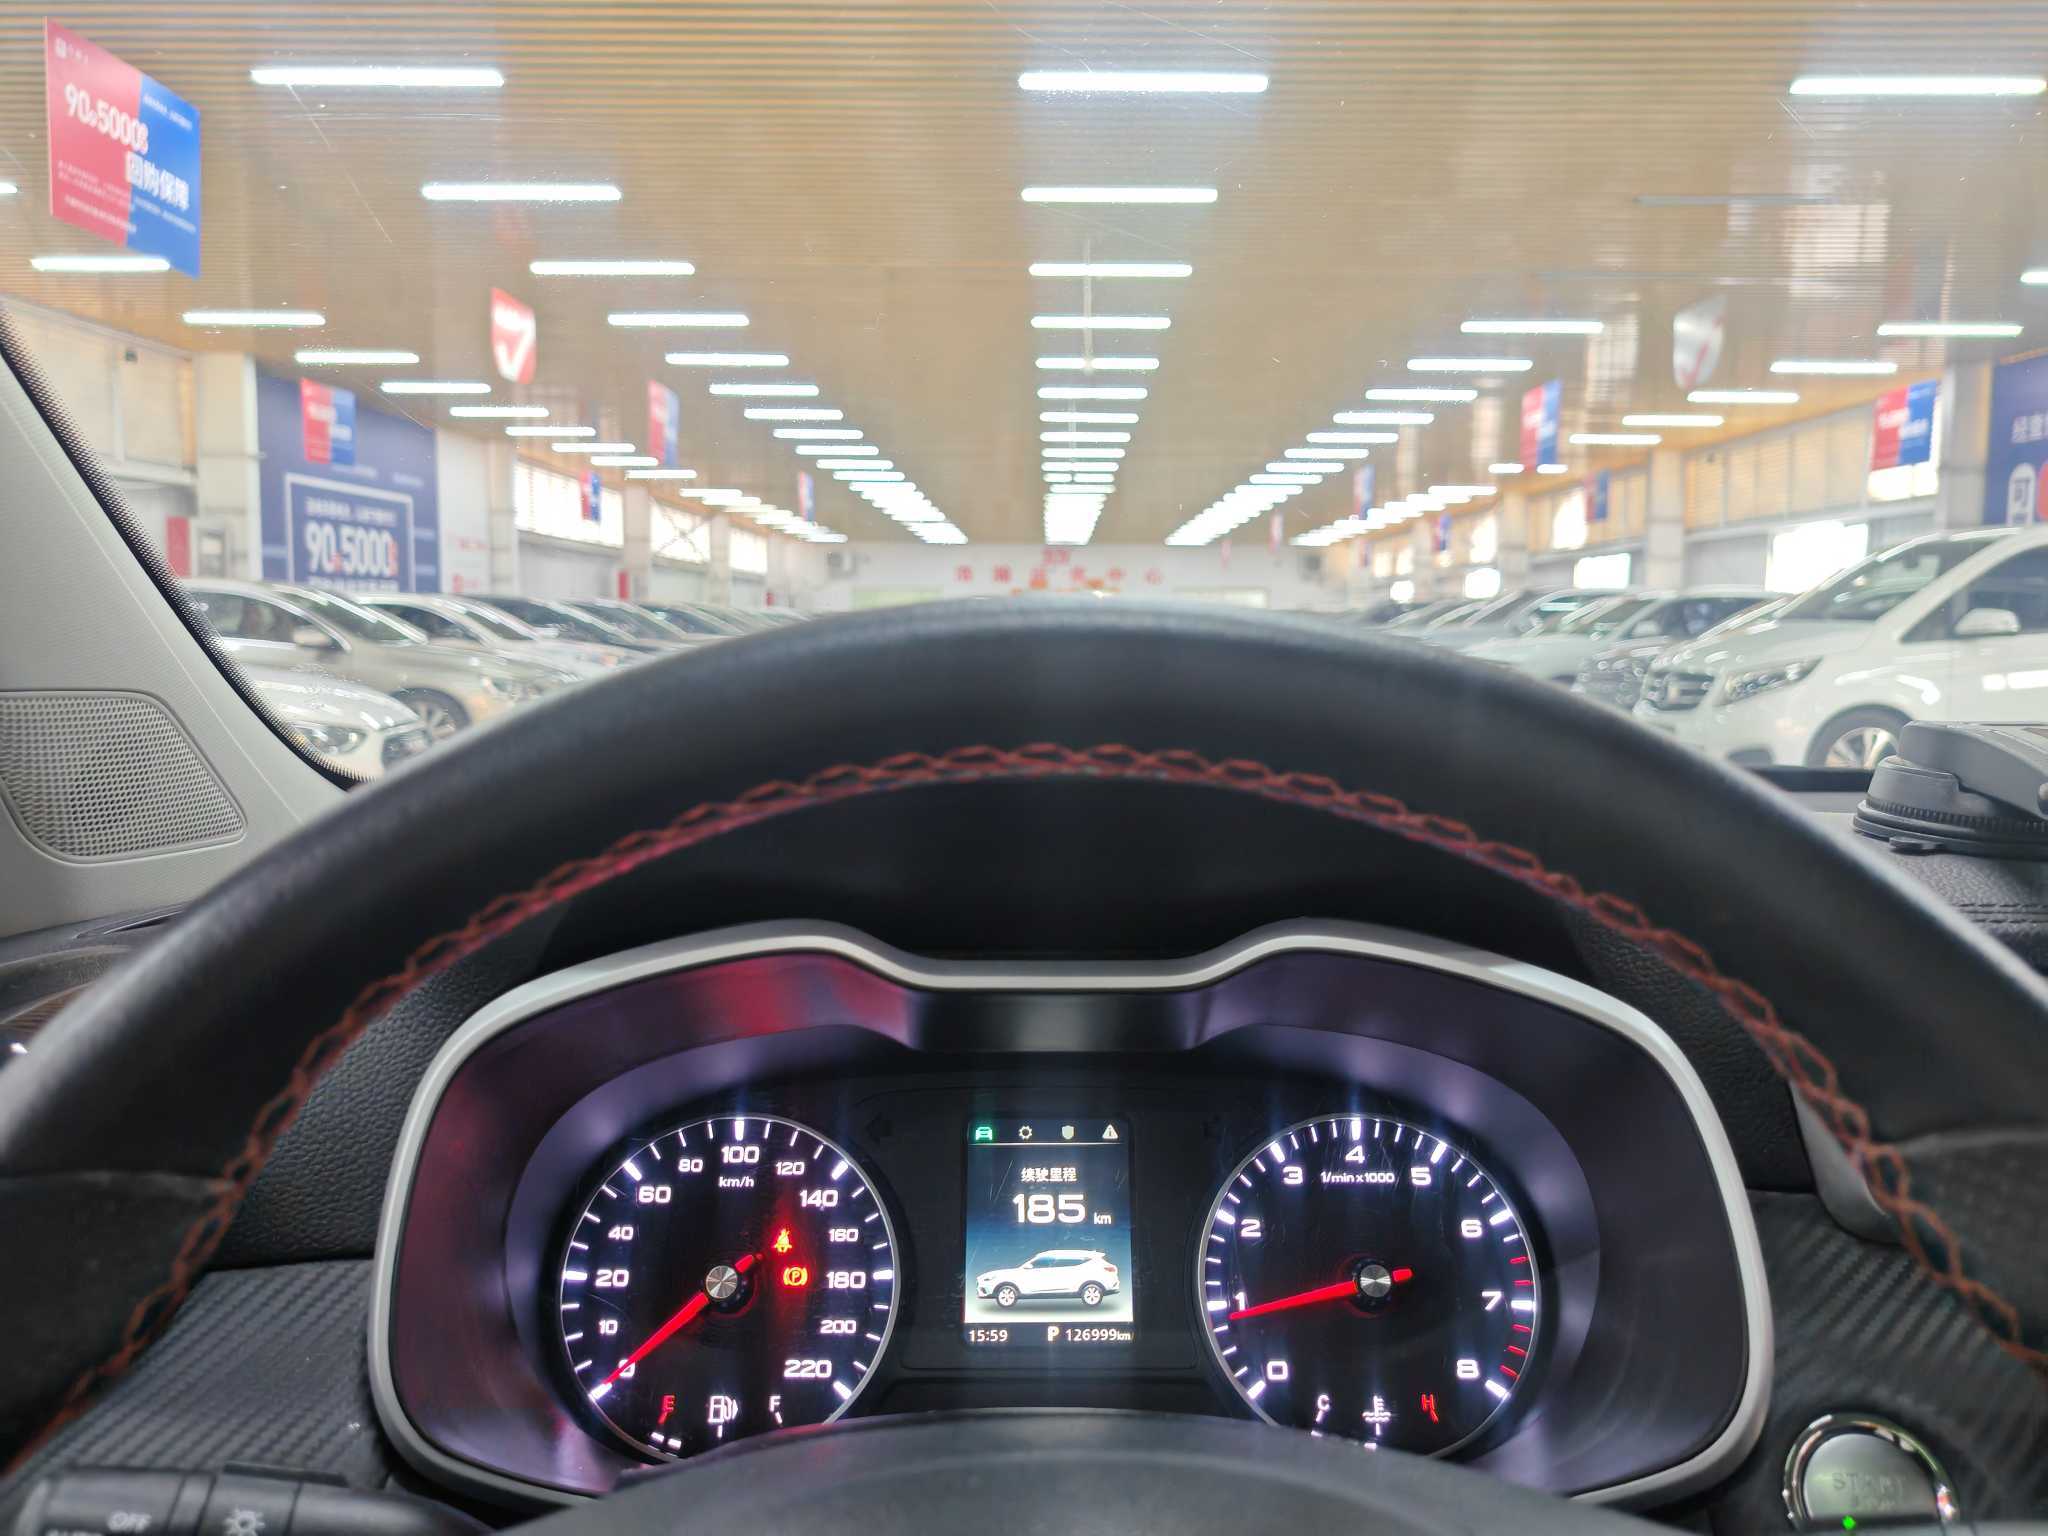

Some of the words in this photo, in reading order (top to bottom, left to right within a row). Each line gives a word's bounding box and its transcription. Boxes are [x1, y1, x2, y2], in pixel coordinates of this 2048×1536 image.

[721, 1145, 760, 1164] 100
[1345, 1145, 1365, 1164] 4
[677, 1158, 704, 1173] 80
[775, 1161, 806, 1177] 120
[718, 1175, 755, 1188] km/h
[1283, 1167, 1303, 1184] 3
[1411, 1167, 1431, 1186] 5
[638, 1186, 672, 1204] 60
[799, 1189, 839, 1208] 140
[1012, 1193, 1086, 1224] 185
[1093, 1211, 1112, 1225] km
[607, 1226, 634, 1241] 40
[828, 1228, 859, 1243] 160
[1240, 1218, 1262, 1238] 2
[1460, 1218, 1483, 1239] 6
[594, 1268, 630, 1288] 20
[825, 1271, 867, 1290] 180
[1234, 1291, 1247, 1311] 1
[1481, 1290, 1504, 1312] 7
[598, 1319, 619, 1336] 10
[819, 1319, 857, 1335] 200
[967, 1328, 1009, 1342] 15:59
[1047, 1326, 1061, 1343] P
[783, 1359, 833, 1379] 220
[1266, 1360, 1289, 1381] 0
[1456, 1358, 1480, 1380] 8
[662, 1394, 676, 1412] E
[768, 1394, 782, 1412] F
[1316, 1394, 1331, 1411] C
[1420, 1393, 1436, 1412] H
[107, 1510, 152, 1533] OFF
